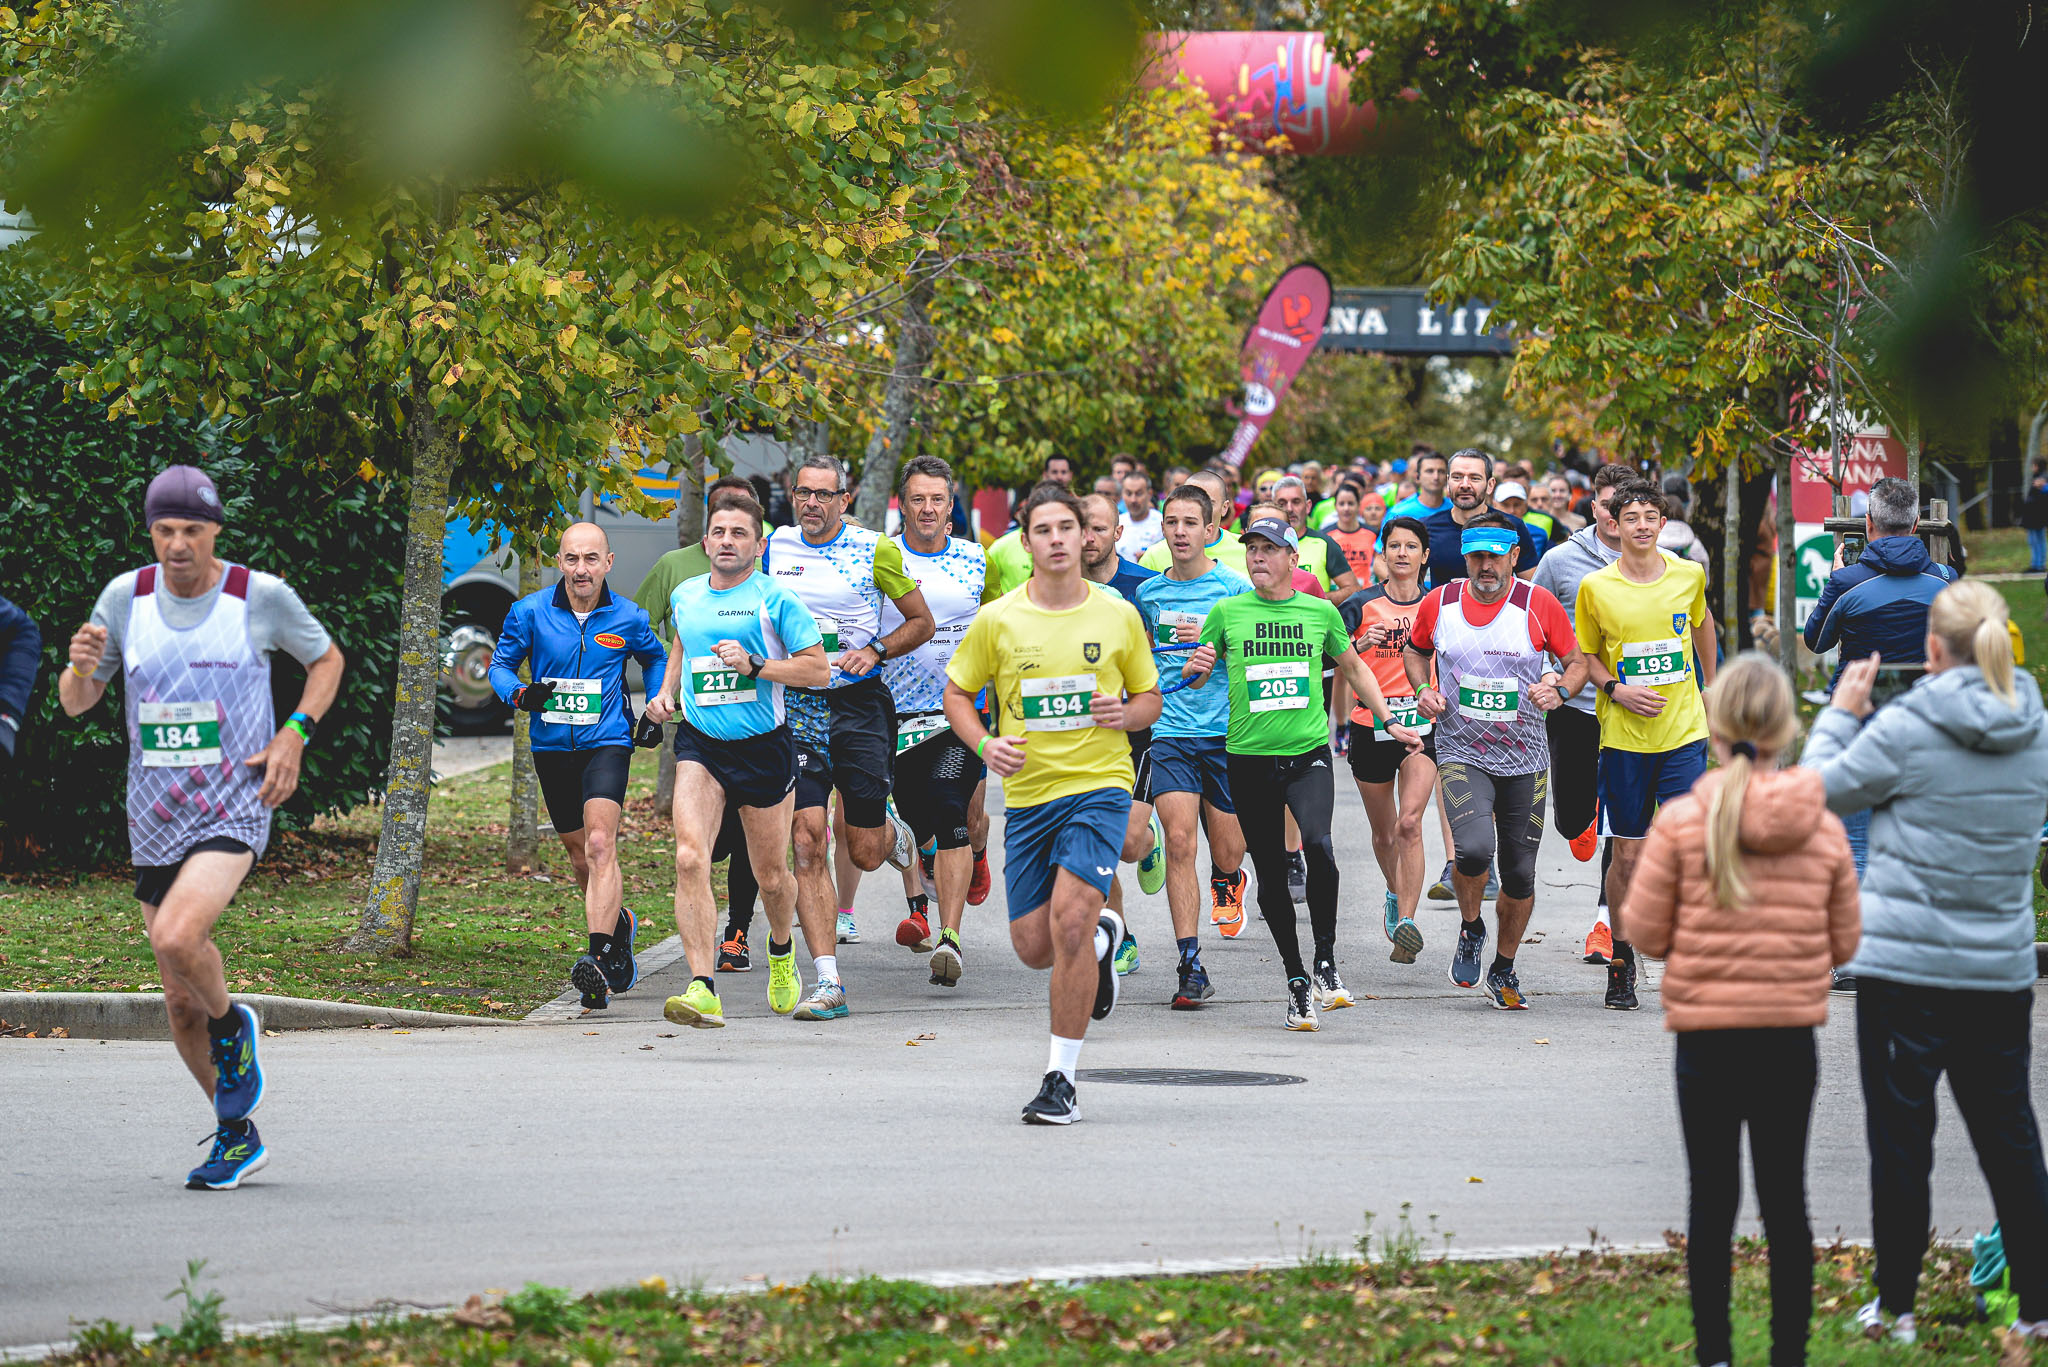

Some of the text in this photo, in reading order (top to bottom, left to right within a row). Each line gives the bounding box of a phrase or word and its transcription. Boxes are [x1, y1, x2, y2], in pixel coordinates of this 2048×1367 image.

[1322, 307, 1388, 335] NA
[1255, 622, 1303, 639] Blind
[1243, 640, 1314, 657] Runner
[1637, 656, 1673, 674] 193
[702, 673, 739, 691] 217
[1259, 679, 1299, 698] 205
[555, 695, 589, 712] 149
[1039, 695, 1083, 717] 194
[1470, 692, 1506, 709] 183
[1393, 710, 1418, 726] 77
[153, 725, 202, 748] 184
